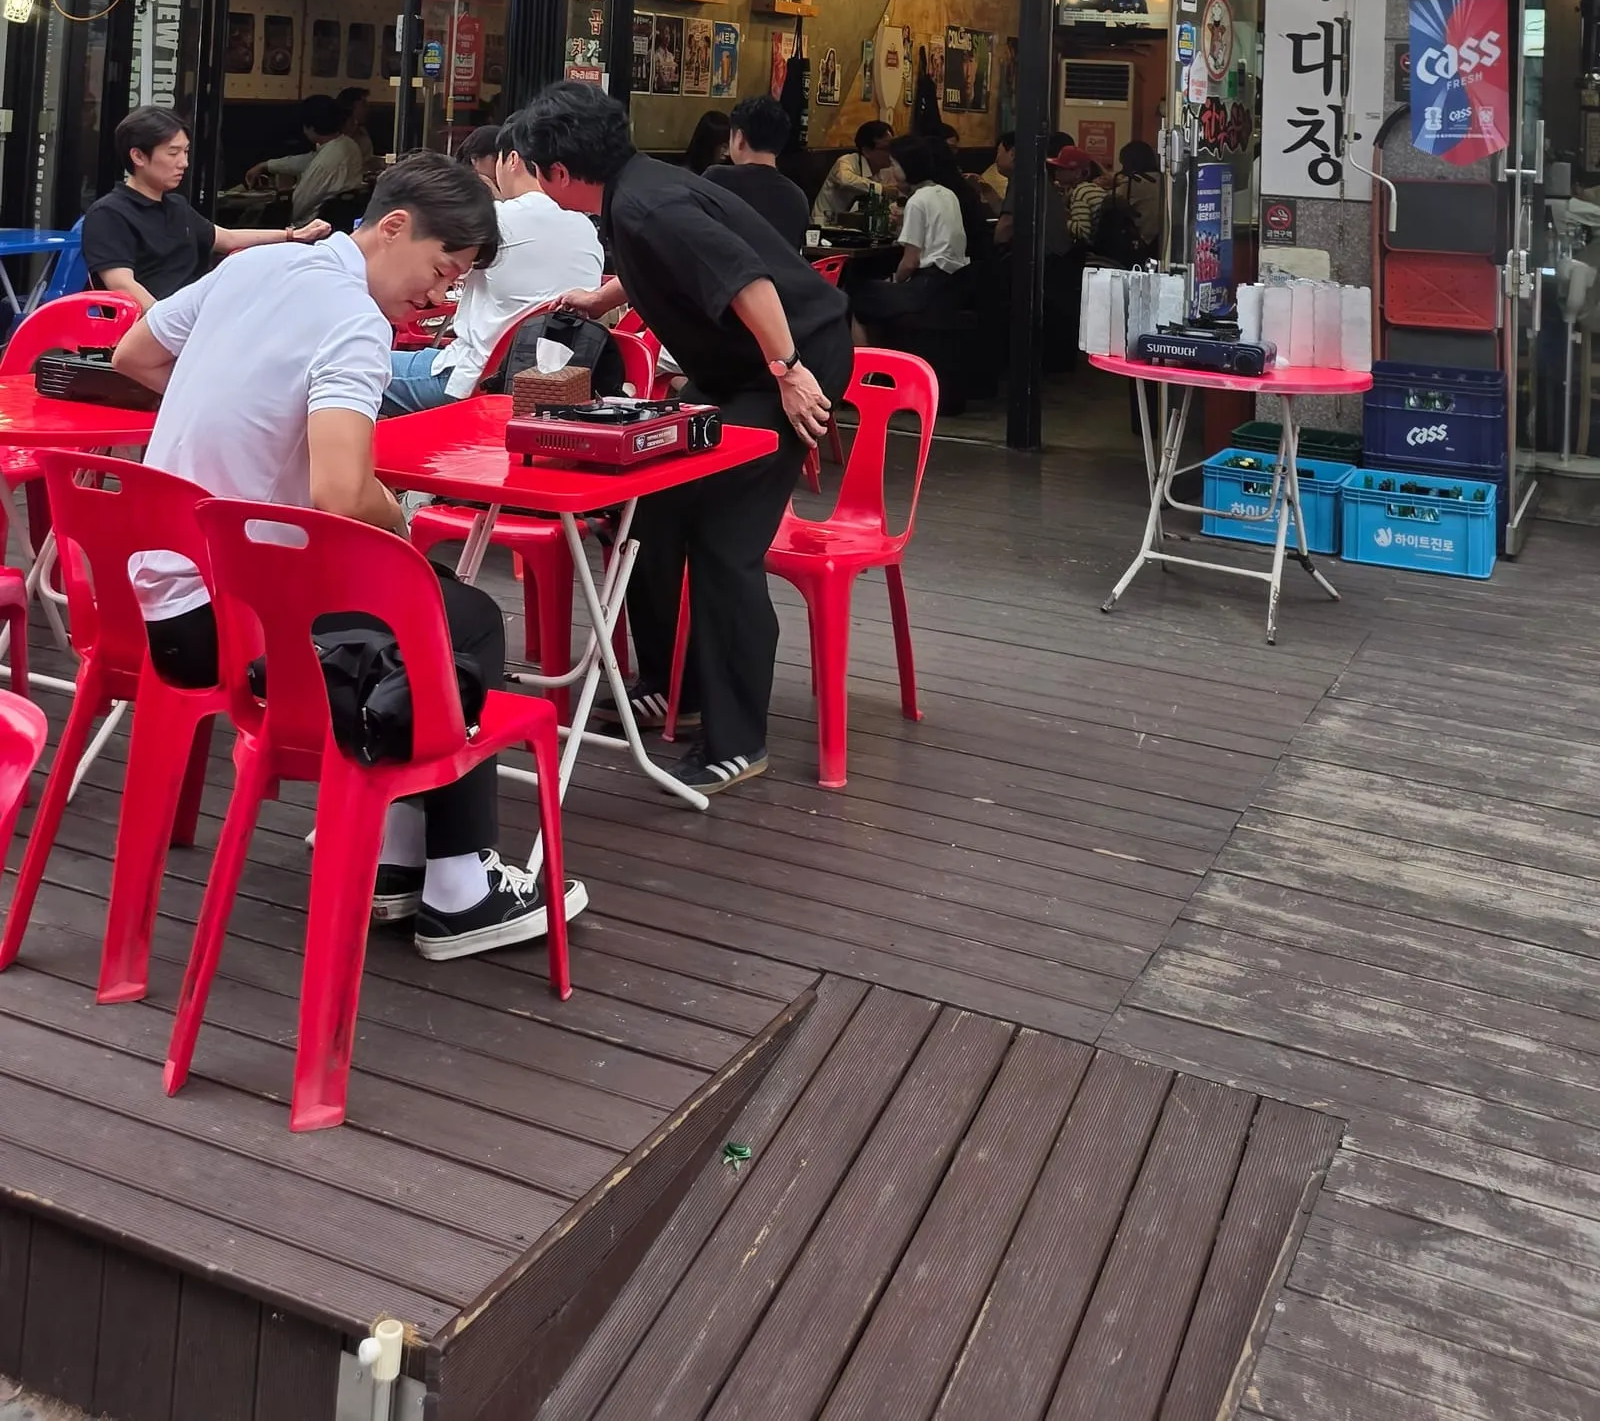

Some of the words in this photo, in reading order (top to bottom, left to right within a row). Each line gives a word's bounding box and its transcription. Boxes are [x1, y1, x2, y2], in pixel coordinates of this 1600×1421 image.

[1446, 72, 1483, 92] FRESH
[1146, 343, 1196, 357] SUNTOUCH
[1394, 532, 1455, 554] 하이트진로
